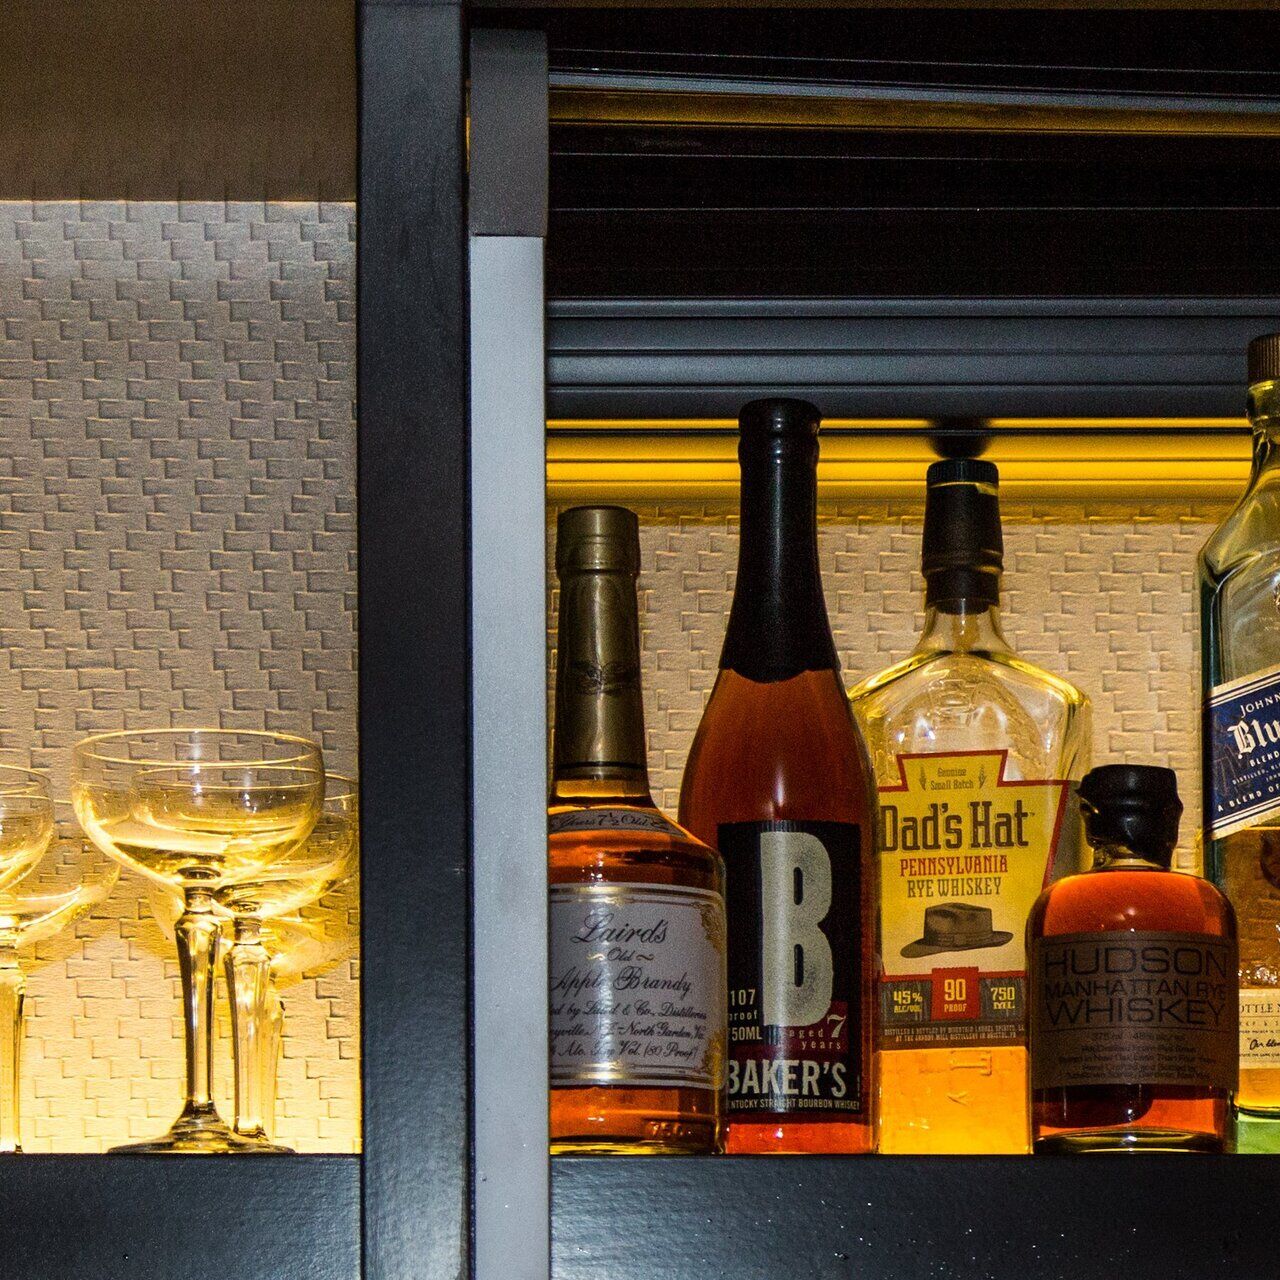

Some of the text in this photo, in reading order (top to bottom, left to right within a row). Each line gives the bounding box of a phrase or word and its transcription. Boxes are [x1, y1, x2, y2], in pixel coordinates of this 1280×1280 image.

[1217, 804, 1224, 813] A
[1229, 789, 1262, 808] BLEND
[1268, 783, 1280, 794] OF
[880, 800, 1030, 853] Dad's Hat
[900, 855, 1009, 877] PENNSYLVANIA
[907, 876, 1003, 899] RYE WHISKEY
[570, 912, 669, 944] Laird's
[760, 831, 834, 1027] B
[606, 948, 635, 962] Old
[1043, 946, 1228, 979] HUDSON
[550, 965, 603, 998] Appl
[943, 978, 967, 1001] 90
[1045, 978, 1190, 999] MANHATTAN
[730, 988, 756, 1006] 107
[990, 986, 1016, 1001] 750
[943, 1003, 967, 1013] PROOF
[1045, 998, 1228, 1028] WHISKEY
[728, 1025, 764, 1042] 50ML
[789, 1014, 847, 1040] aged 7
[801, 1041, 841, 1051] years
[728, 1058, 847, 1098] BAKER'S
[729, 1100, 758, 1110] NTUCKY
[798, 1099, 833, 1109] BOURBON
